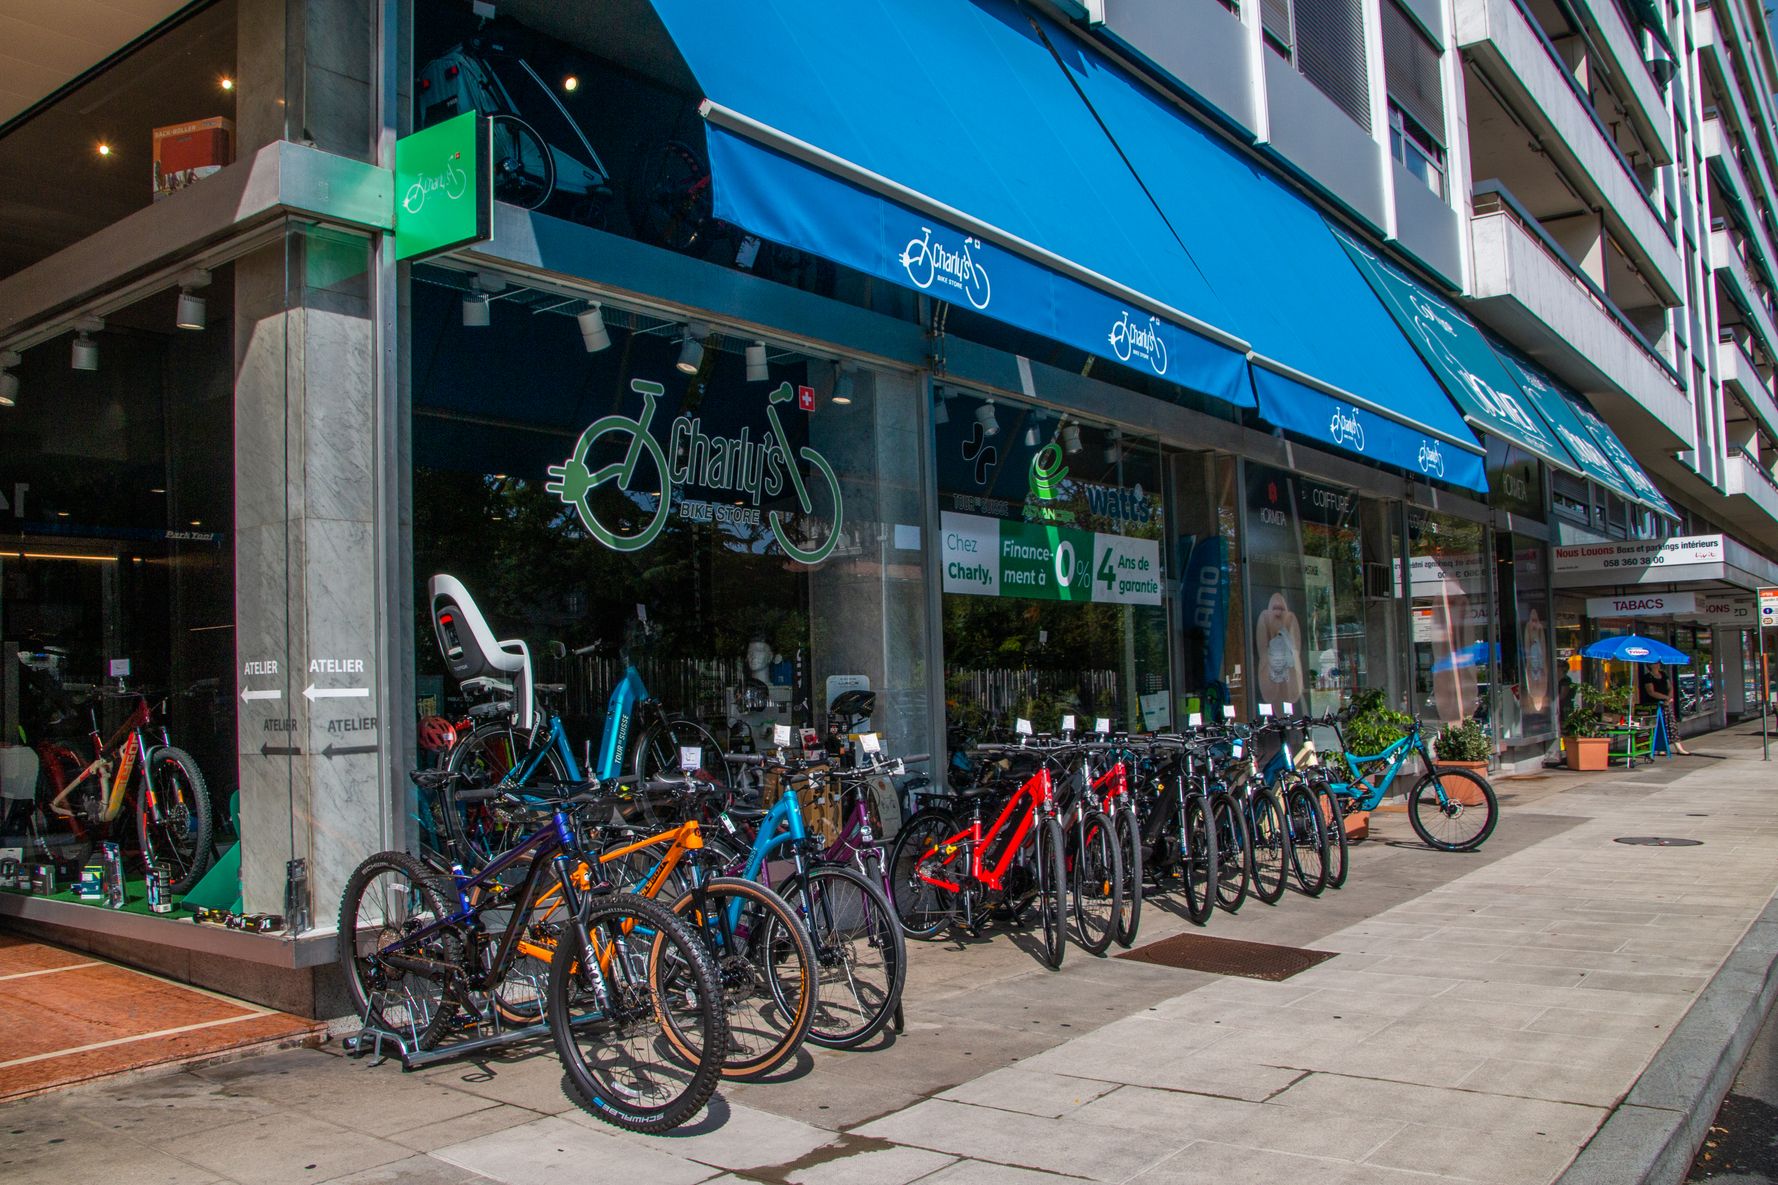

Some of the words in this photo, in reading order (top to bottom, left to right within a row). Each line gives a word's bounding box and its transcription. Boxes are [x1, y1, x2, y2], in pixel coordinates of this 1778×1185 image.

[933, 243, 970, 282] Charly's
[668, 416, 785, 506] Charly's
[1313, 488, 1350, 513] COIFFURE
[680, 502, 713, 520] BIKE
[716, 505, 760, 525] STORE
[165, 530, 190, 539] Park
[947, 534, 977, 553] Chez
[1003, 540, 1054, 560] Finance-
[1556, 548, 1579, 558] Nous
[1581, 546, 1615, 557] Louons
[1636, 545, 1644, 553] et
[1645, 541, 1679, 554] parkings
[1681, 539, 1719, 550] intérieurs
[1096, 548, 1116, 590] 4
[1118, 554, 1136, 570] Ans
[1138, 555, 1150, 571] de
[1603, 558, 1619, 568] 058
[1621, 557, 1638, 567] 360
[1640, 557, 1651, 566] 38
[1652, 556, 1664, 564] 00
[948, 562, 992, 585] Charly,
[1004, 570, 1035, 585] ment
[1038, 570, 1046, 585] à
[1119, 579, 1158, 595] garantie
[1613, 598, 1664, 612] TABACS
[244, 660, 278, 675] ATELIER
[309, 659, 364, 673] ATELIER
[614, 745, 624, 764] TOUR
[619, 714, 629, 740] SUISSE
[602, 1104, 664, 1123] SCHWALBE
